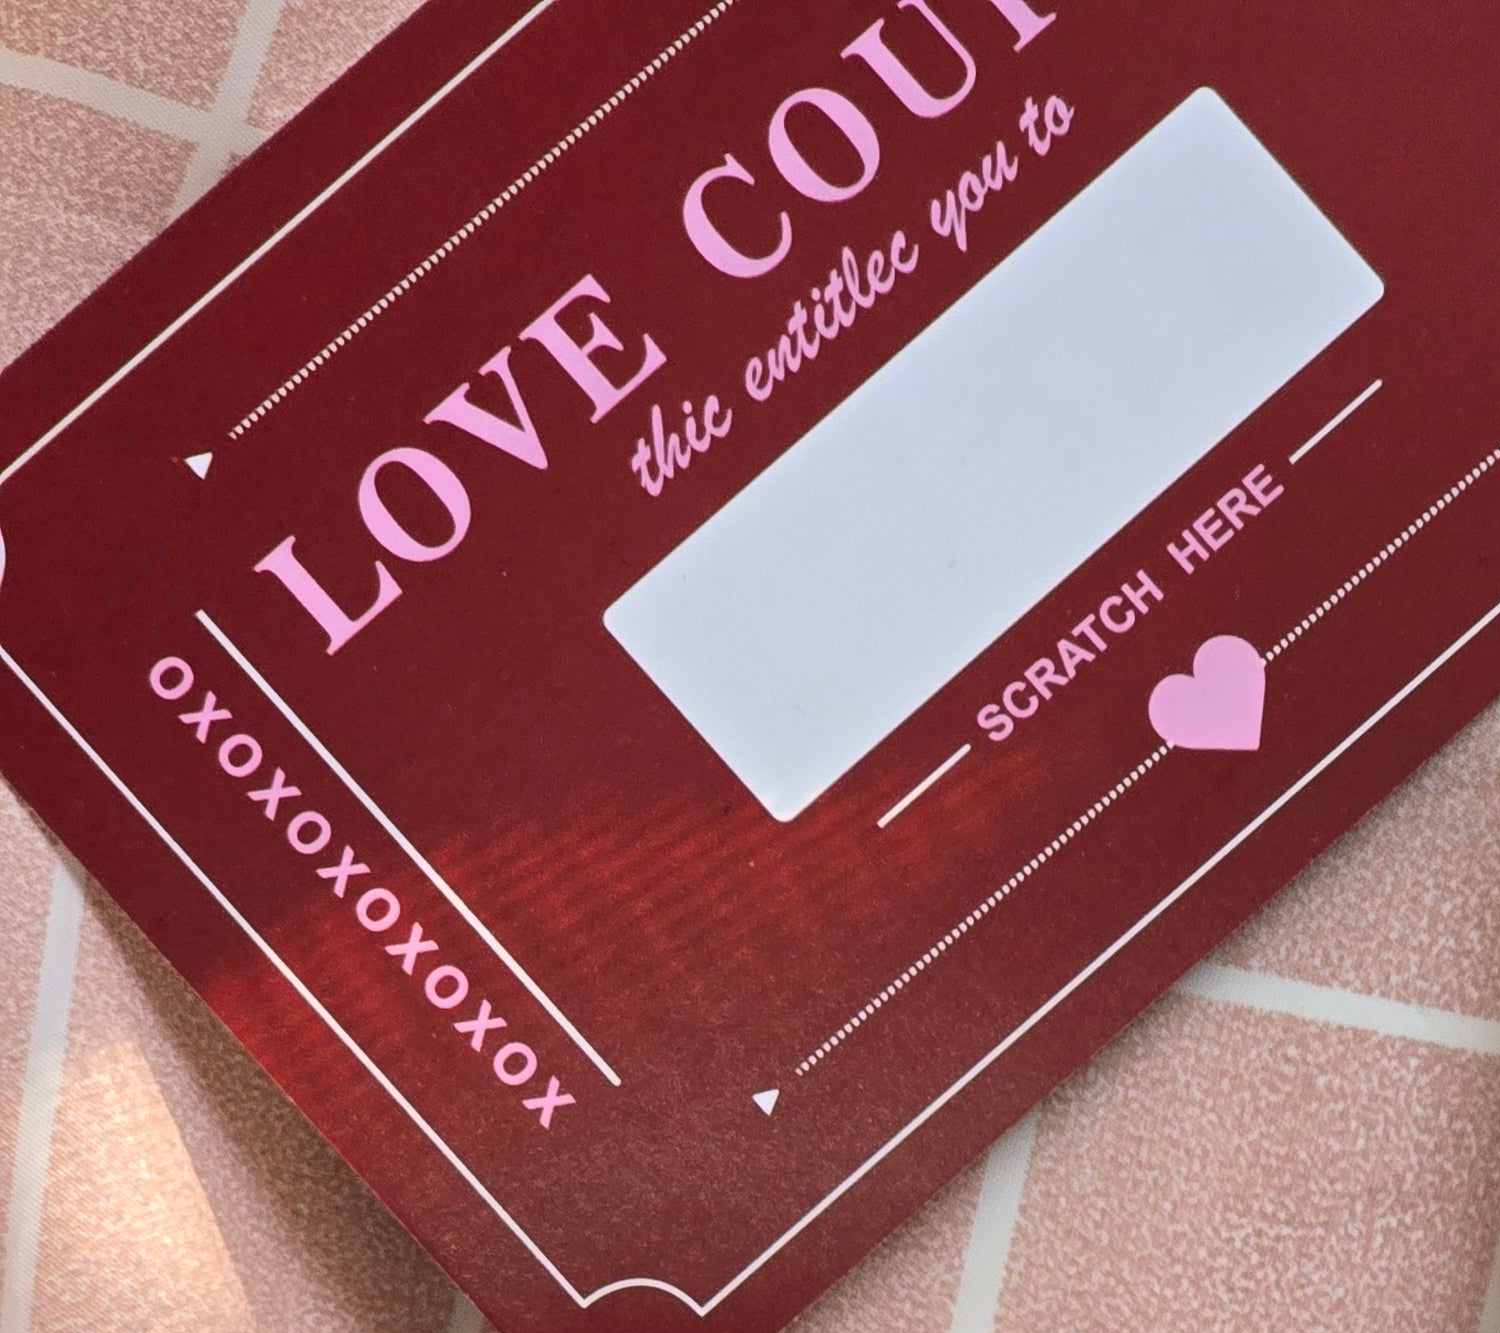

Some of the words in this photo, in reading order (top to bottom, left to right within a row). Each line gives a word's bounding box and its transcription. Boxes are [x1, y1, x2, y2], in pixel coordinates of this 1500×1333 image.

[930, 140, 1018, 252] you
[1018, 94, 1075, 156] to
[253, 273, 667, 655] LOVE
[976, 569, 1164, 741] SCRATCH
[1166, 463, 1285, 575] HERE
